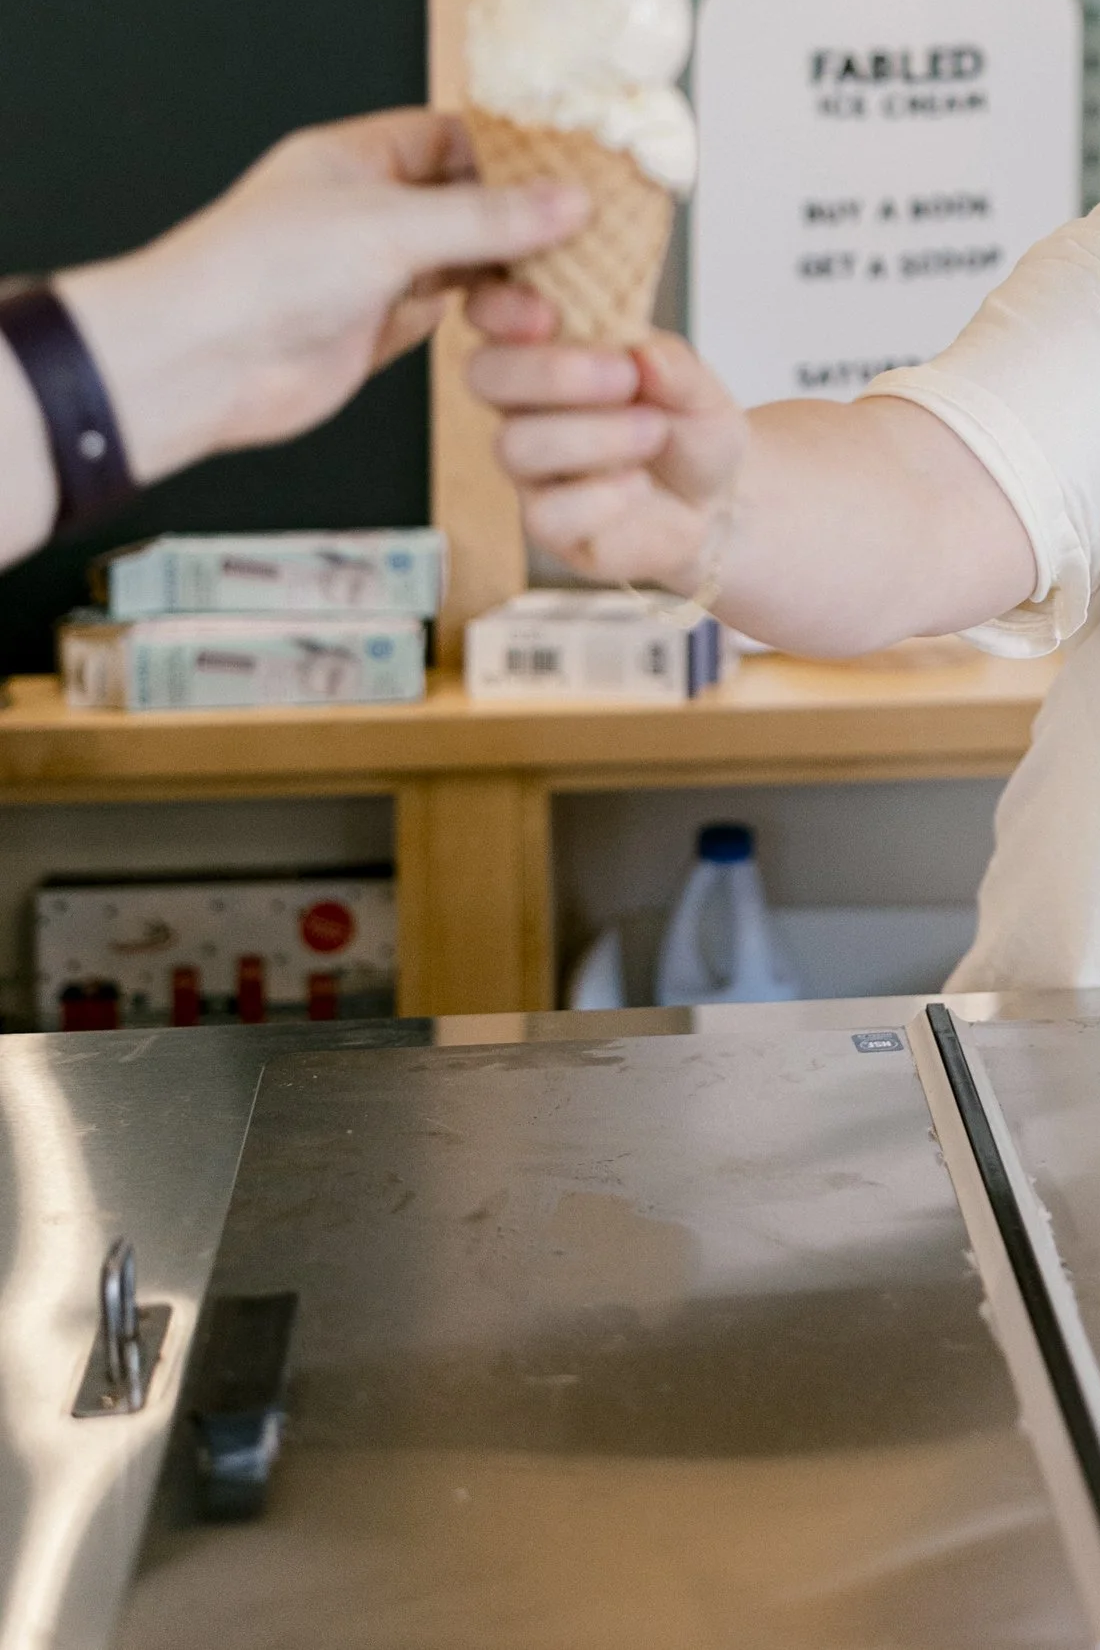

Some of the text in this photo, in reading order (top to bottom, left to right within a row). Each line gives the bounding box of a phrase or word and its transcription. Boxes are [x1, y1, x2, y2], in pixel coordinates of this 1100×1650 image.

[811, 46, 986, 83] FABLED
[819, 90, 987, 119] ICE CREAM
